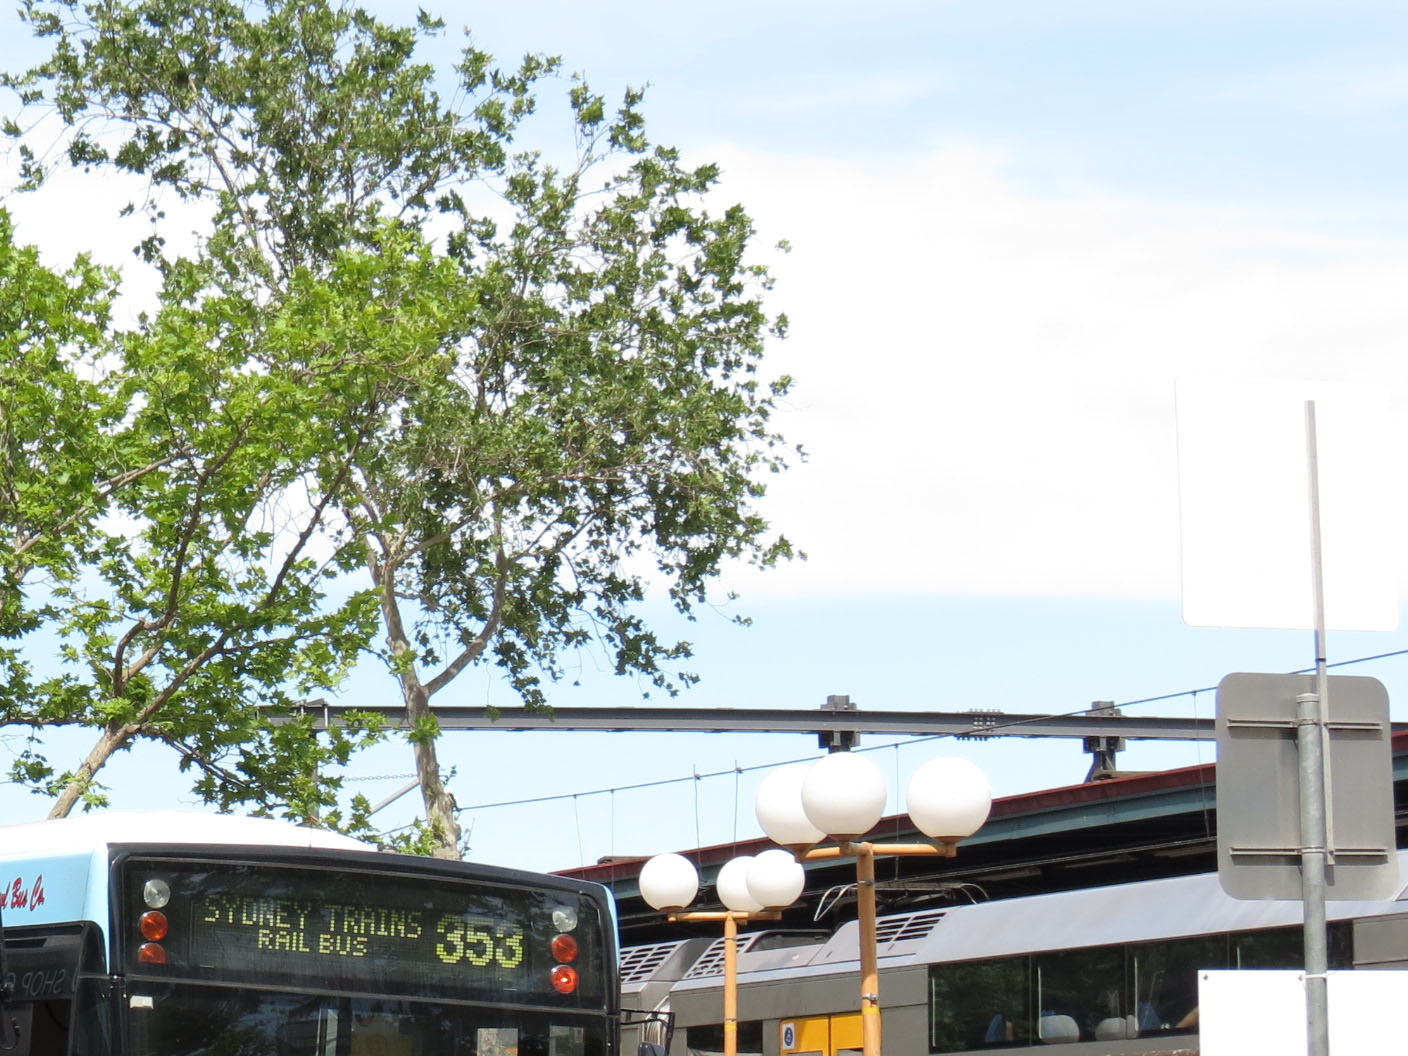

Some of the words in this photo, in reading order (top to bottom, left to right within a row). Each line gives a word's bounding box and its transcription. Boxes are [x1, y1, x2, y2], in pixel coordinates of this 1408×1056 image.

[11, 877, 28, 909] Bus
[204, 897, 312, 929] SYDNEY
[325, 904, 423, 939] TRAINS
[436, 913, 524, 969] 353
[258, 928, 310, 953] RAIL
[319, 933, 368, 957] BUS
